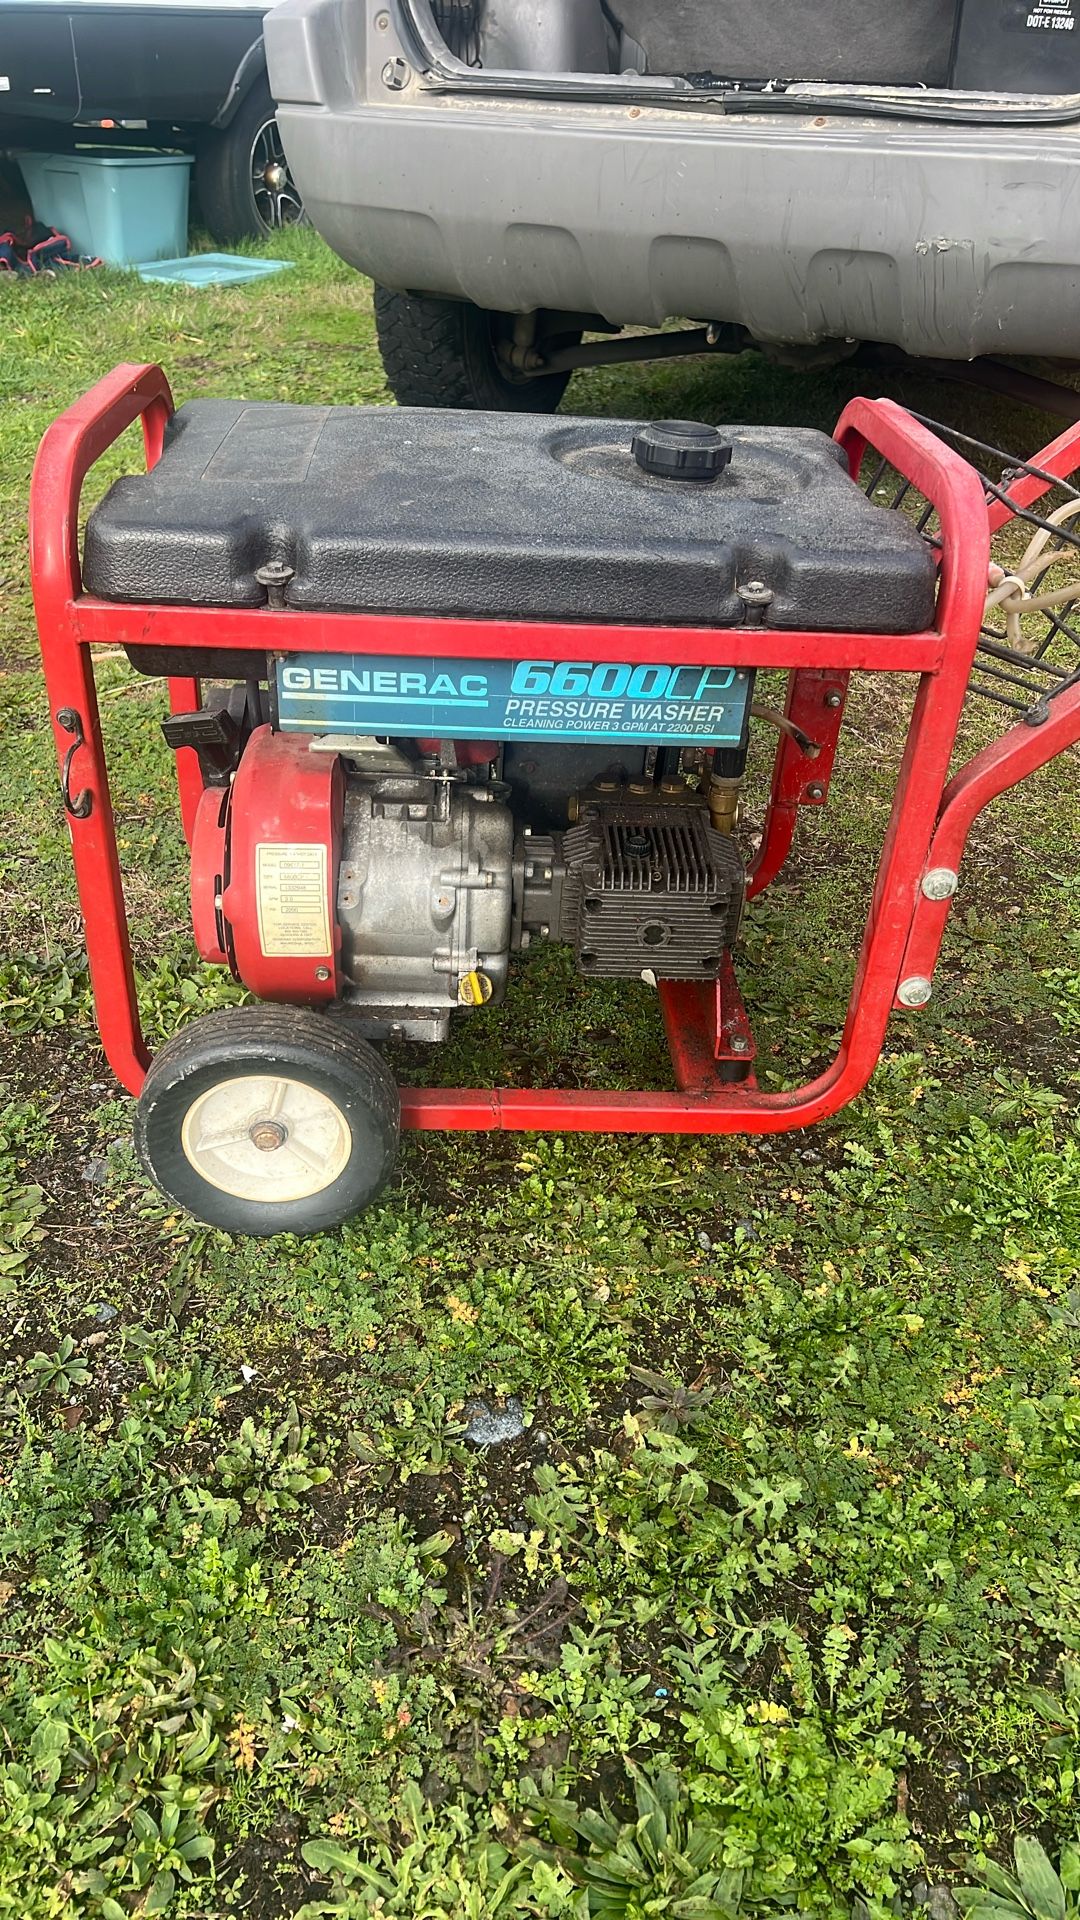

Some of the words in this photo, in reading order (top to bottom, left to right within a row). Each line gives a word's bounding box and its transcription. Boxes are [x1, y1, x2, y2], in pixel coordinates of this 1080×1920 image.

[1026, 15, 1051, 28] DOT-E
[1051, 16, 1075, 30] 13246
[282, 667, 488, 696] GENERAC
[510, 660, 736, 700] 6600CP
[505, 699, 625, 719] PRESSURE
[631, 703, 724, 722] WASHER
[503, 717, 564, 729] CLEANING
[566, 720, 610, 731] POWER
[611, 722, 620, 731] 3
[621, 721, 648, 732] GPM
[649, 723, 666, 732] AT
[666, 723, 694, 733] 2200
[694, 724, 715, 733] PSI
